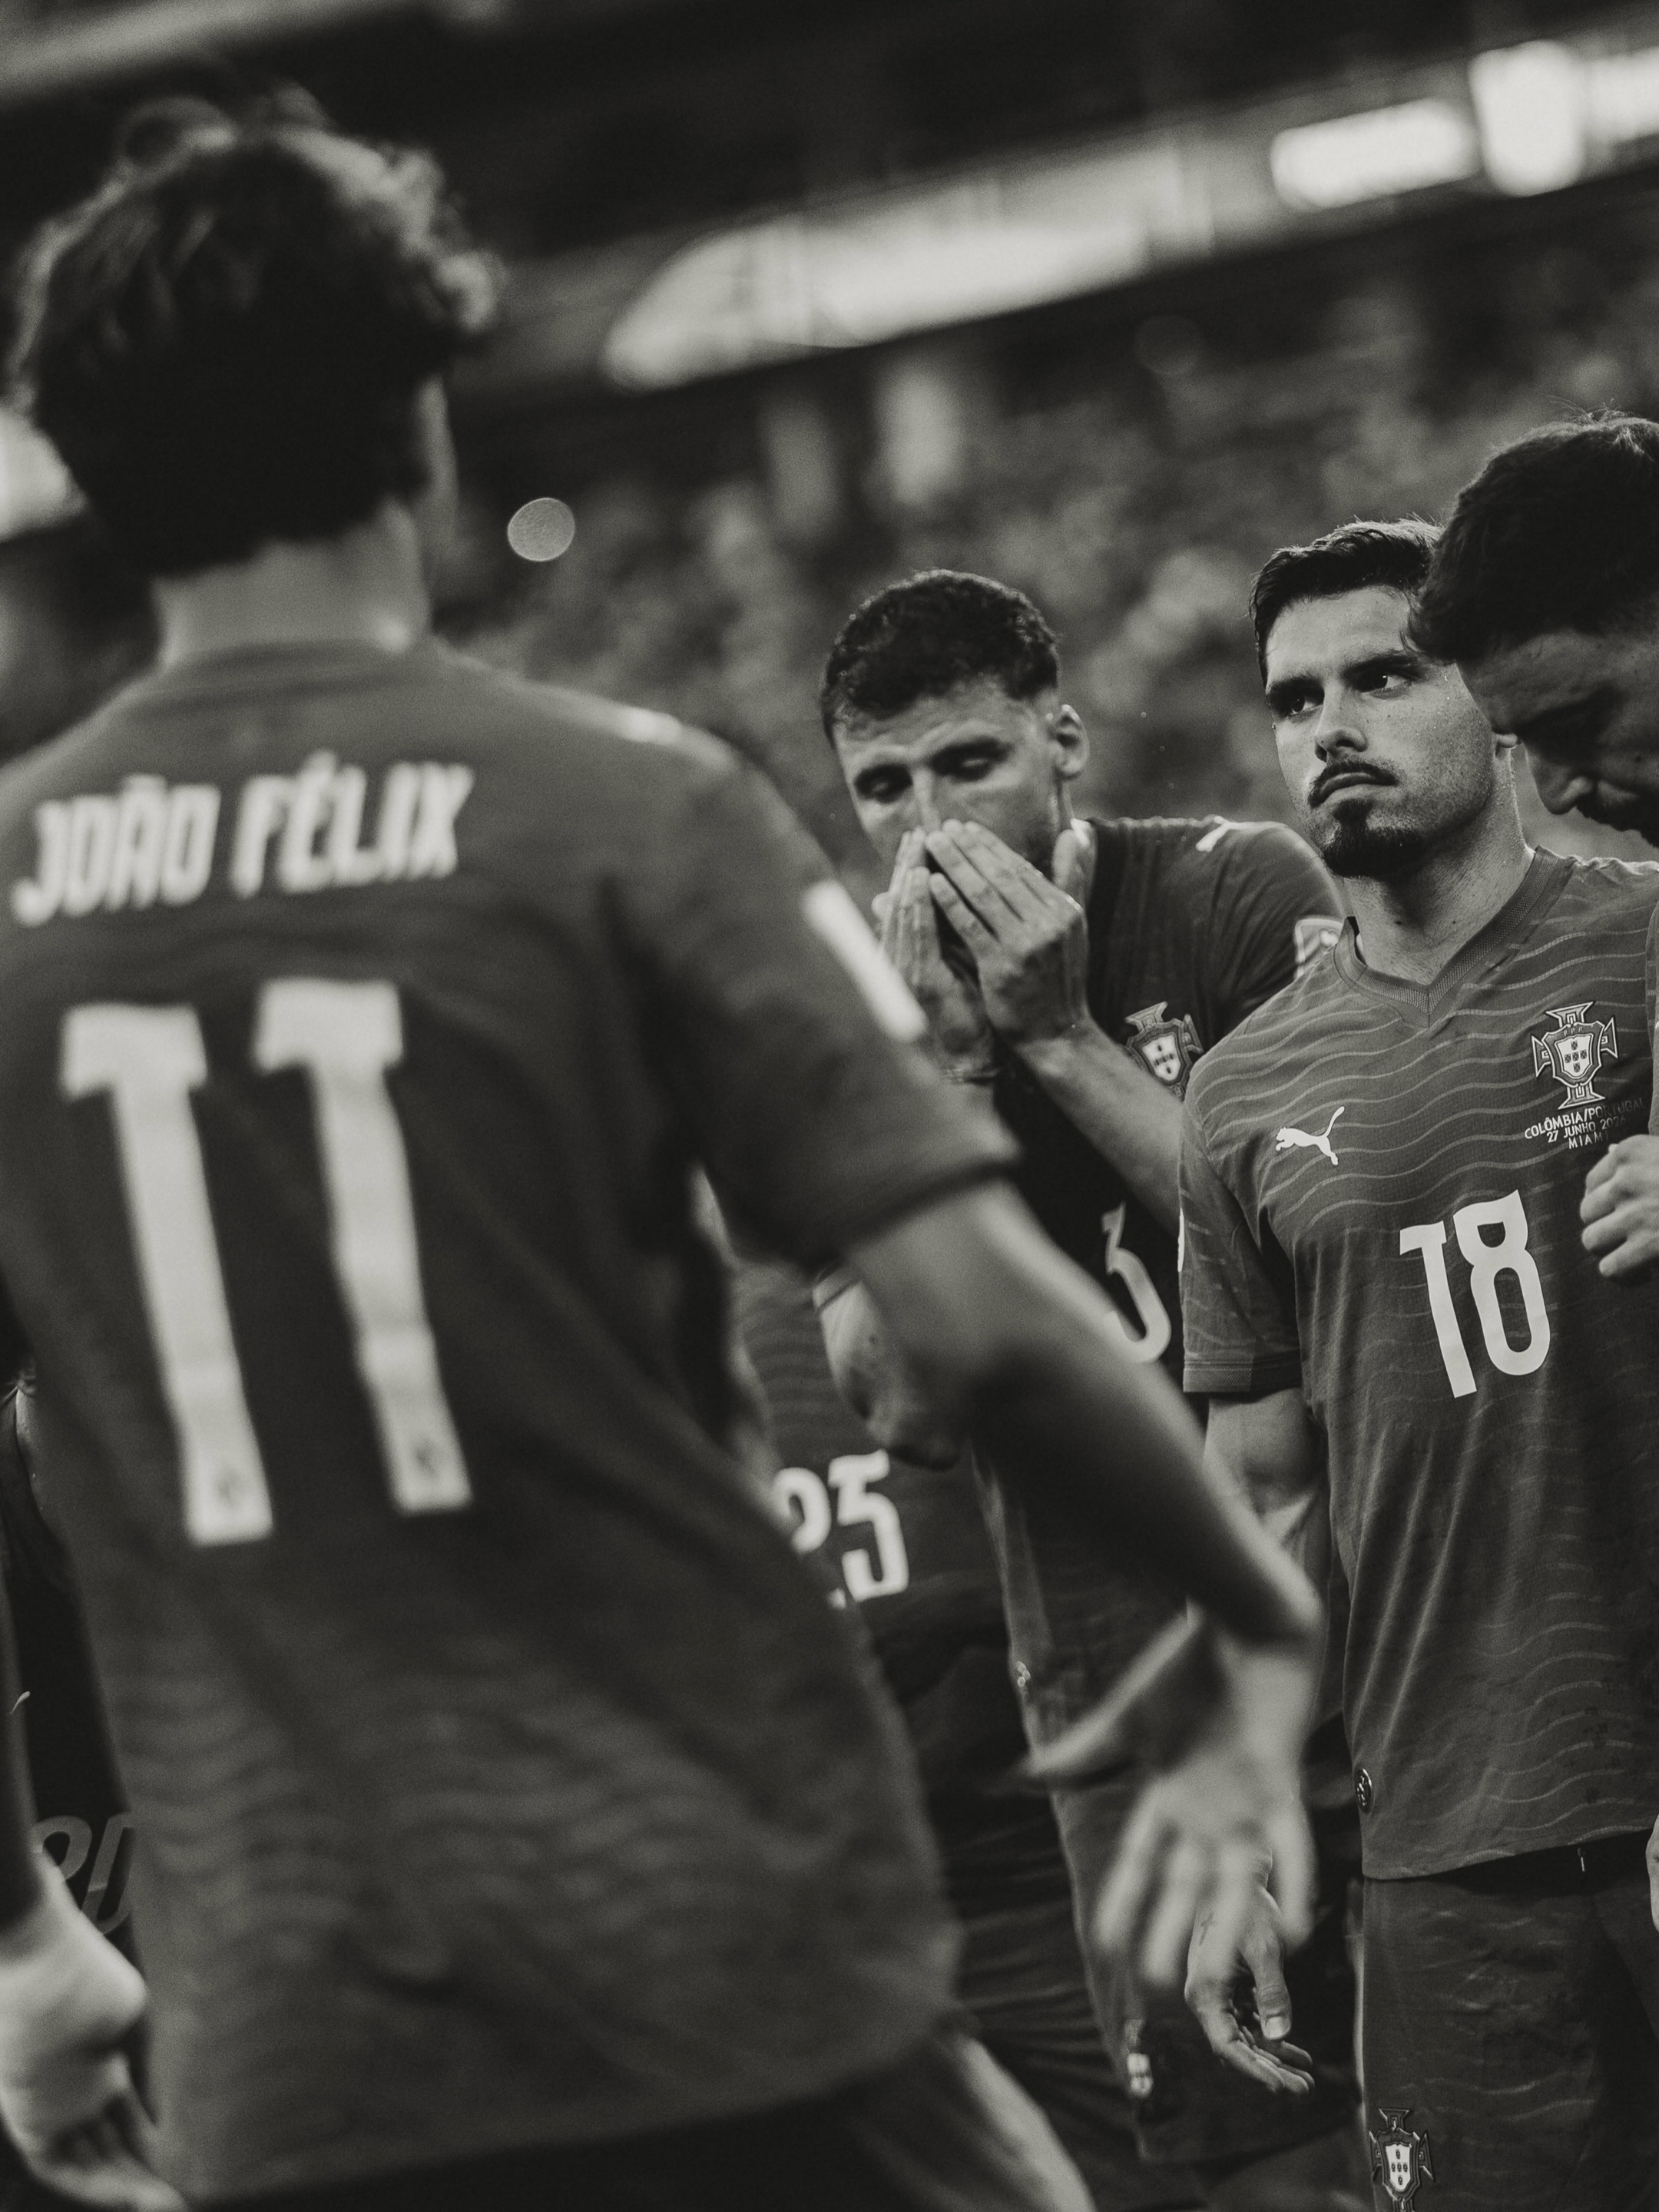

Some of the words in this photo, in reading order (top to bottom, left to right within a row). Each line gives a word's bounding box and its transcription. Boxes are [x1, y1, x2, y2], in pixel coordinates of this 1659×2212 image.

[12, 773, 221, 925] JOÃO
[232, 748, 474, 899] FÉLIX
[1546, 1131, 1558, 1143] 27
[1563, 1121, 1596, 1138] JUNHO
[1568, 1131, 1608, 1149] MIAMI
[61, 975, 472, 1546] 11
[1399, 1189, 1550, 1398] 18
